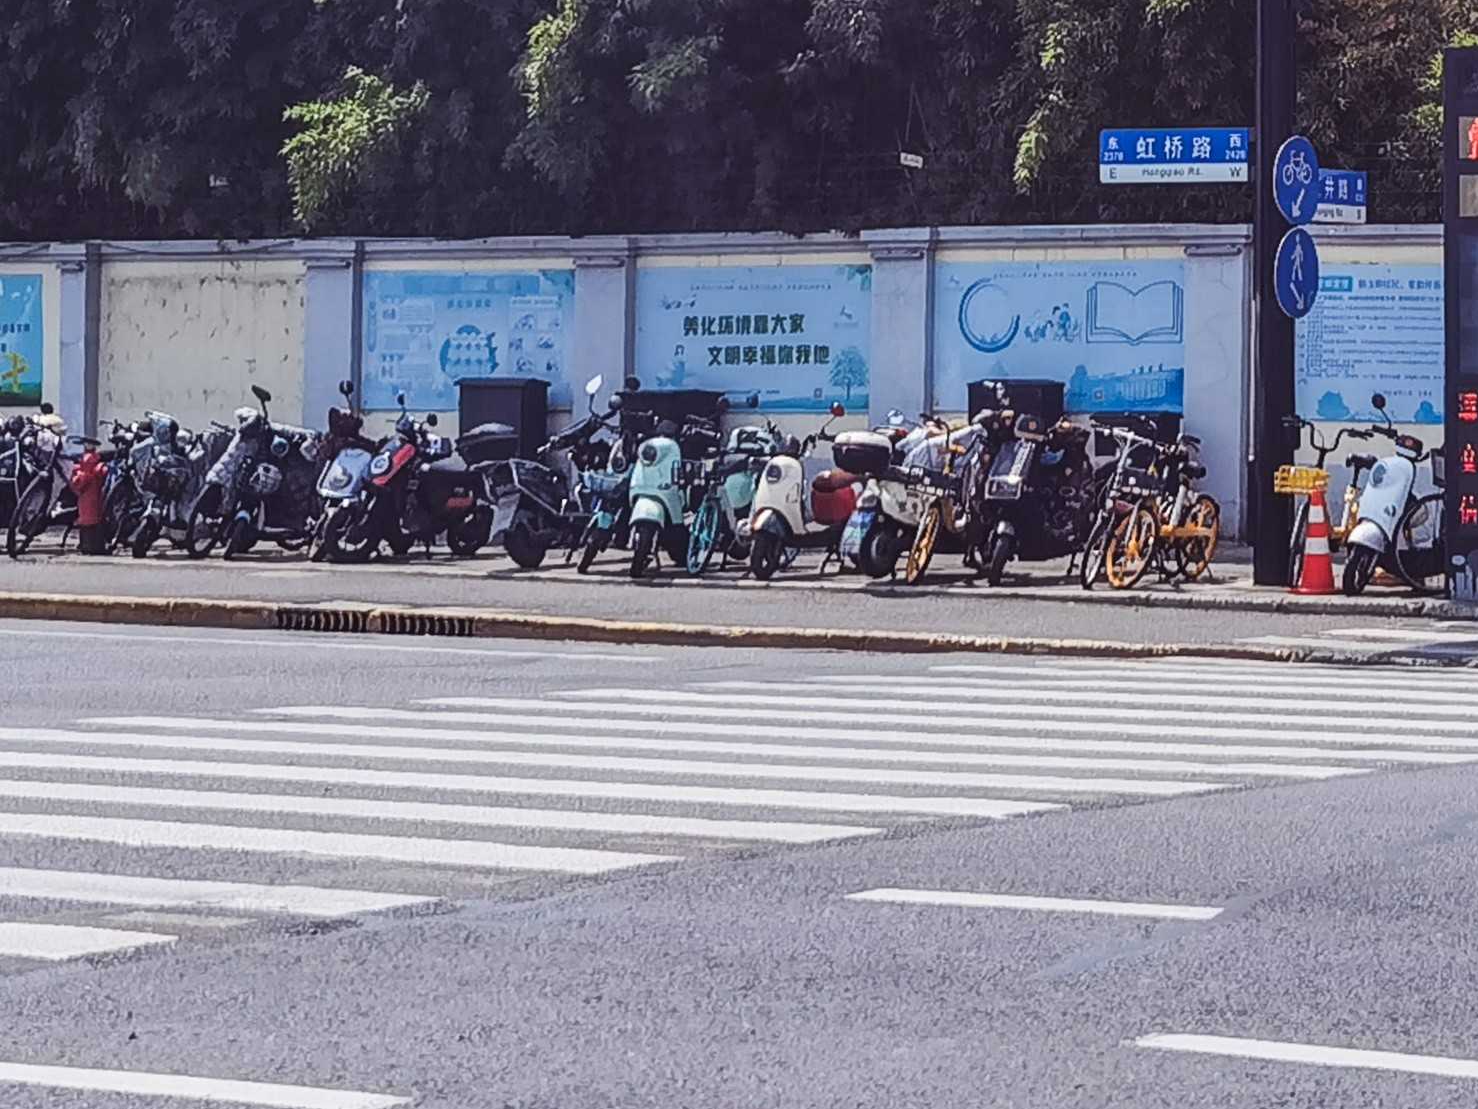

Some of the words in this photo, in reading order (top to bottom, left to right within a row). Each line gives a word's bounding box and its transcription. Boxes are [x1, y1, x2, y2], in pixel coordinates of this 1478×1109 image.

[1108, 136, 1119, 150] 东
[1136, 135, 1212, 160] 虹桥路
[1229, 133, 1242, 148] 西
[1109, 167, 1118, 180] E
[1230, 167, 1243, 178] W
[683, 313, 805, 336] 美化环境靠大家
[707, 344, 830, 366] 文明幸福你我他
